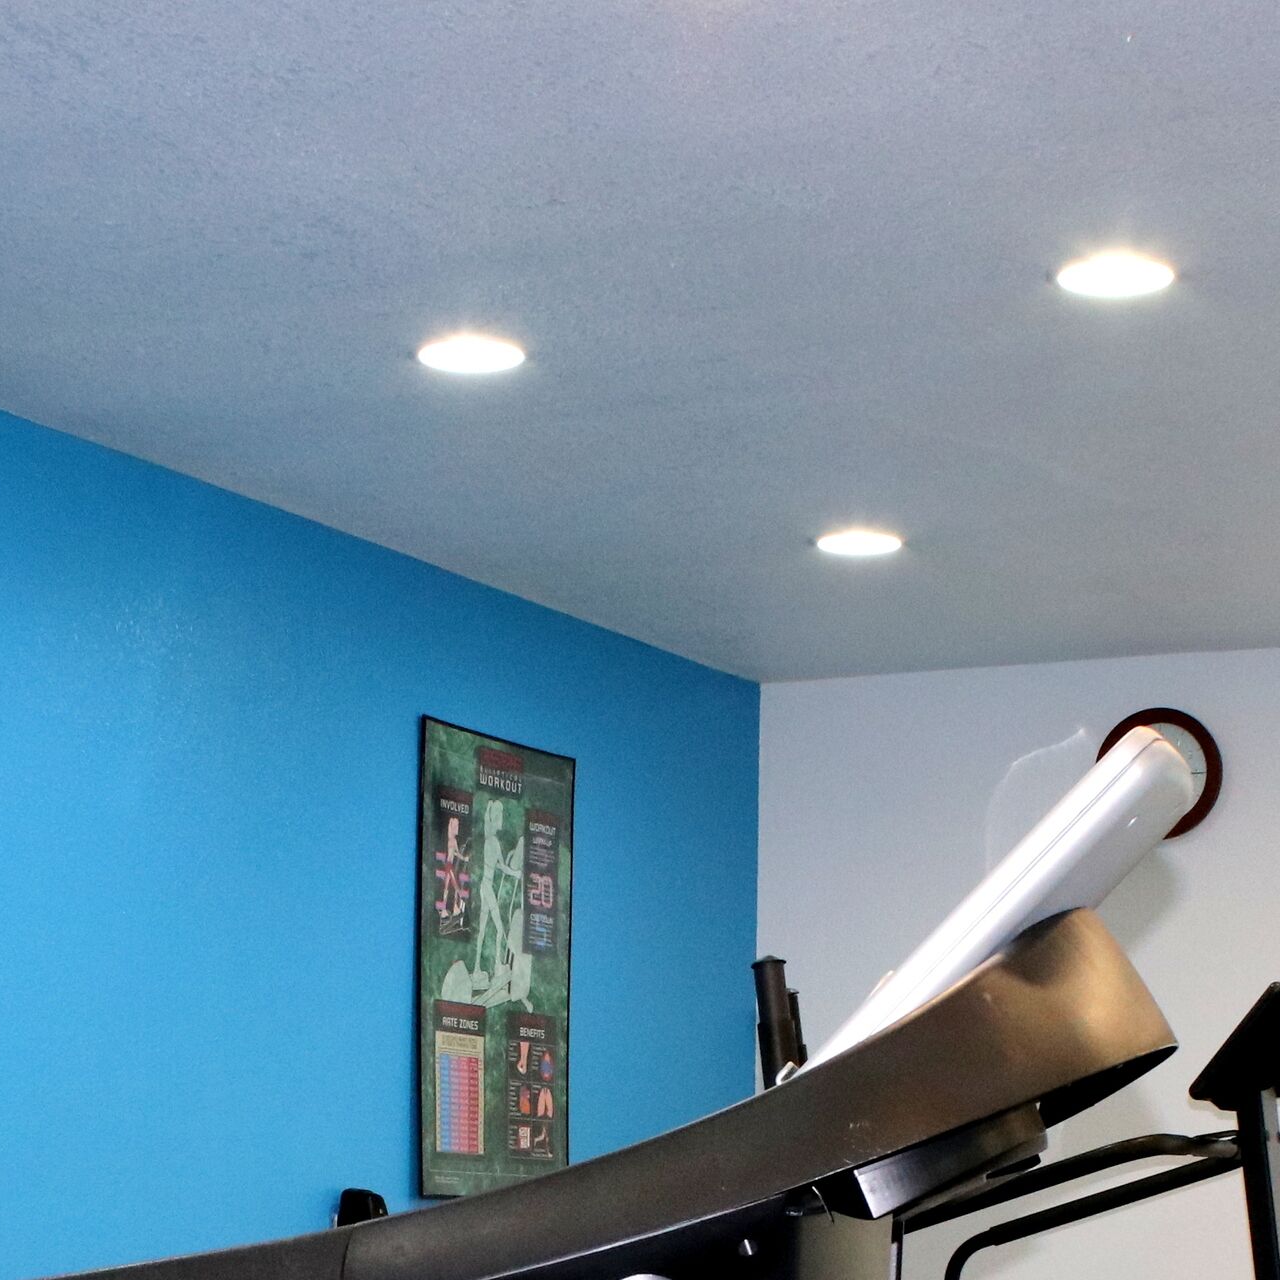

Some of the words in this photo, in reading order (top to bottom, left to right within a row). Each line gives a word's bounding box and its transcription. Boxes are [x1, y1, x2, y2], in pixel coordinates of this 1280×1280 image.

[480, 773, 522, 794] WORKOUT
[440, 798, 470, 815] INVOLVED
[442, 1016, 459, 1028] RATE
[459, 1018, 480, 1031] ZONES
[519, 1026, 545, 1039] BENEFITS
